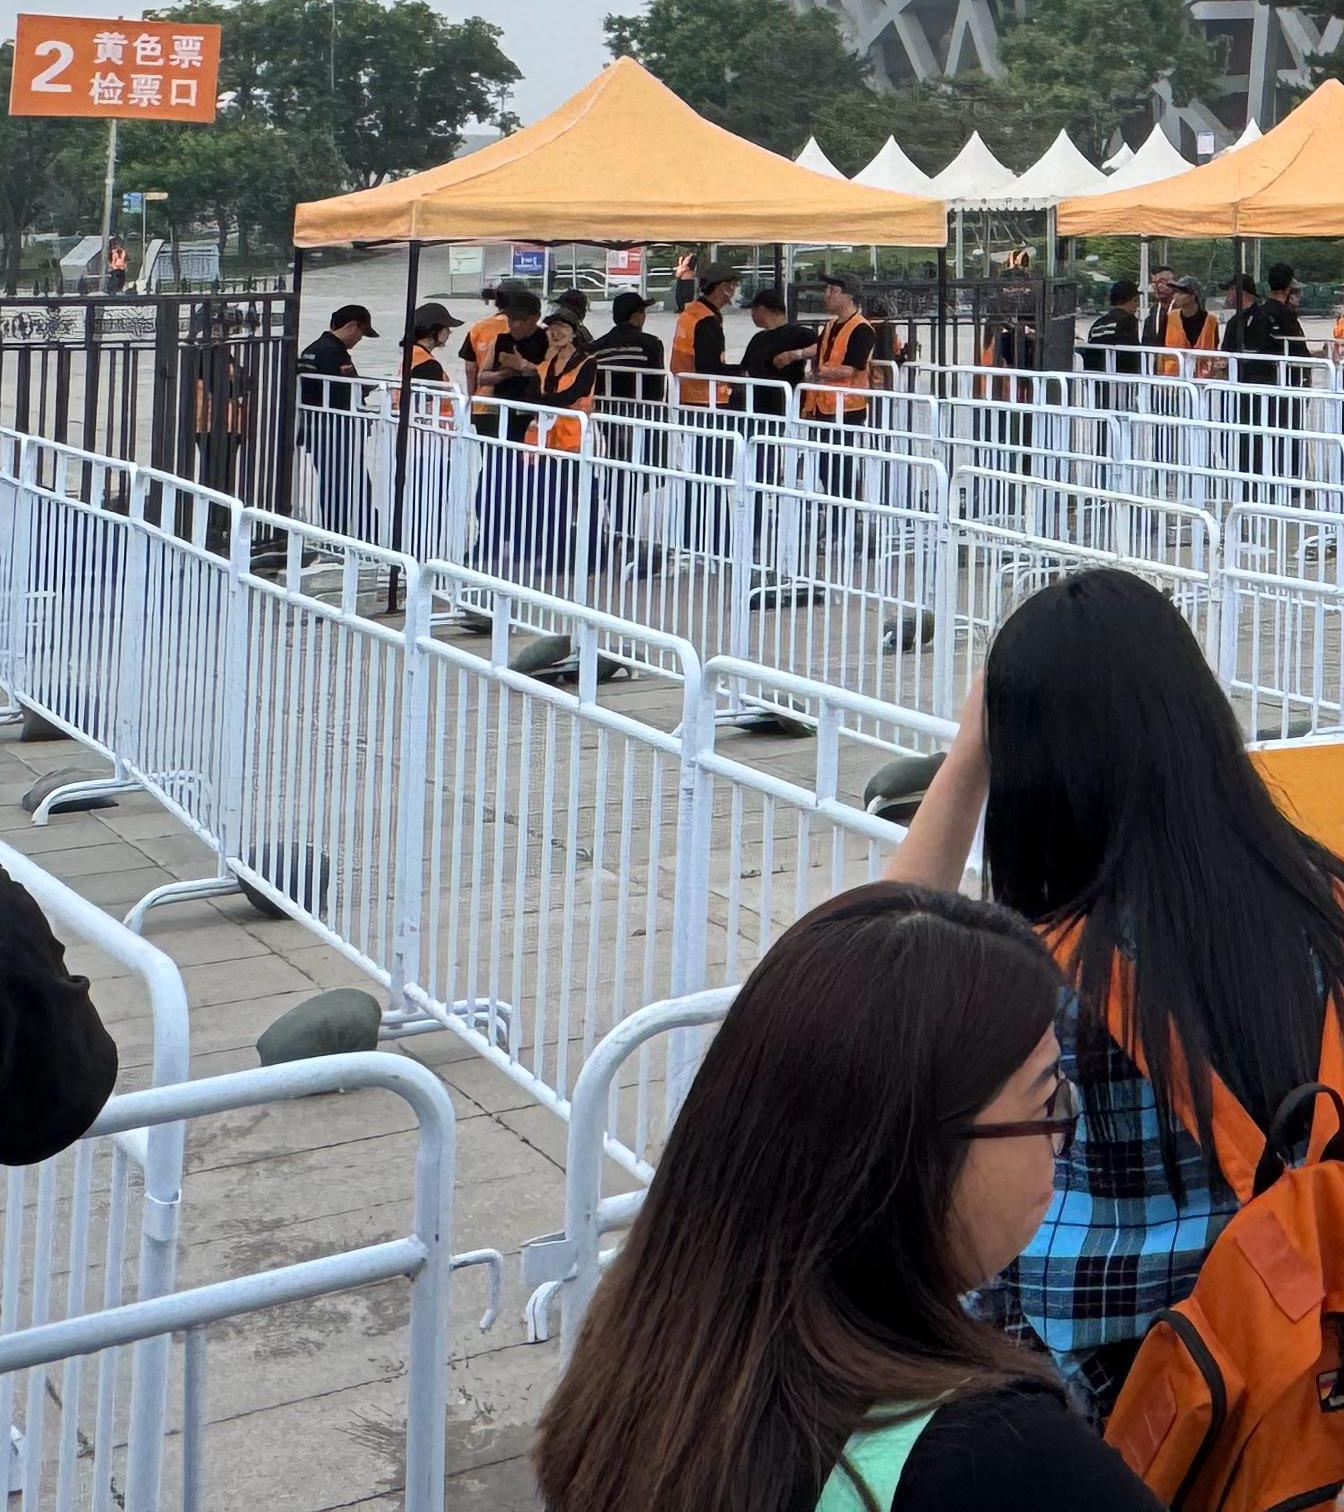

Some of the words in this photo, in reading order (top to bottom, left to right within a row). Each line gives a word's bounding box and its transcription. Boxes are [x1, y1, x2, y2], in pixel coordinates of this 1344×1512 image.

[31, 40, 74, 93] 2
[93, 31, 205, 68] 黄色票
[88, 71, 199, 108] 检票口
